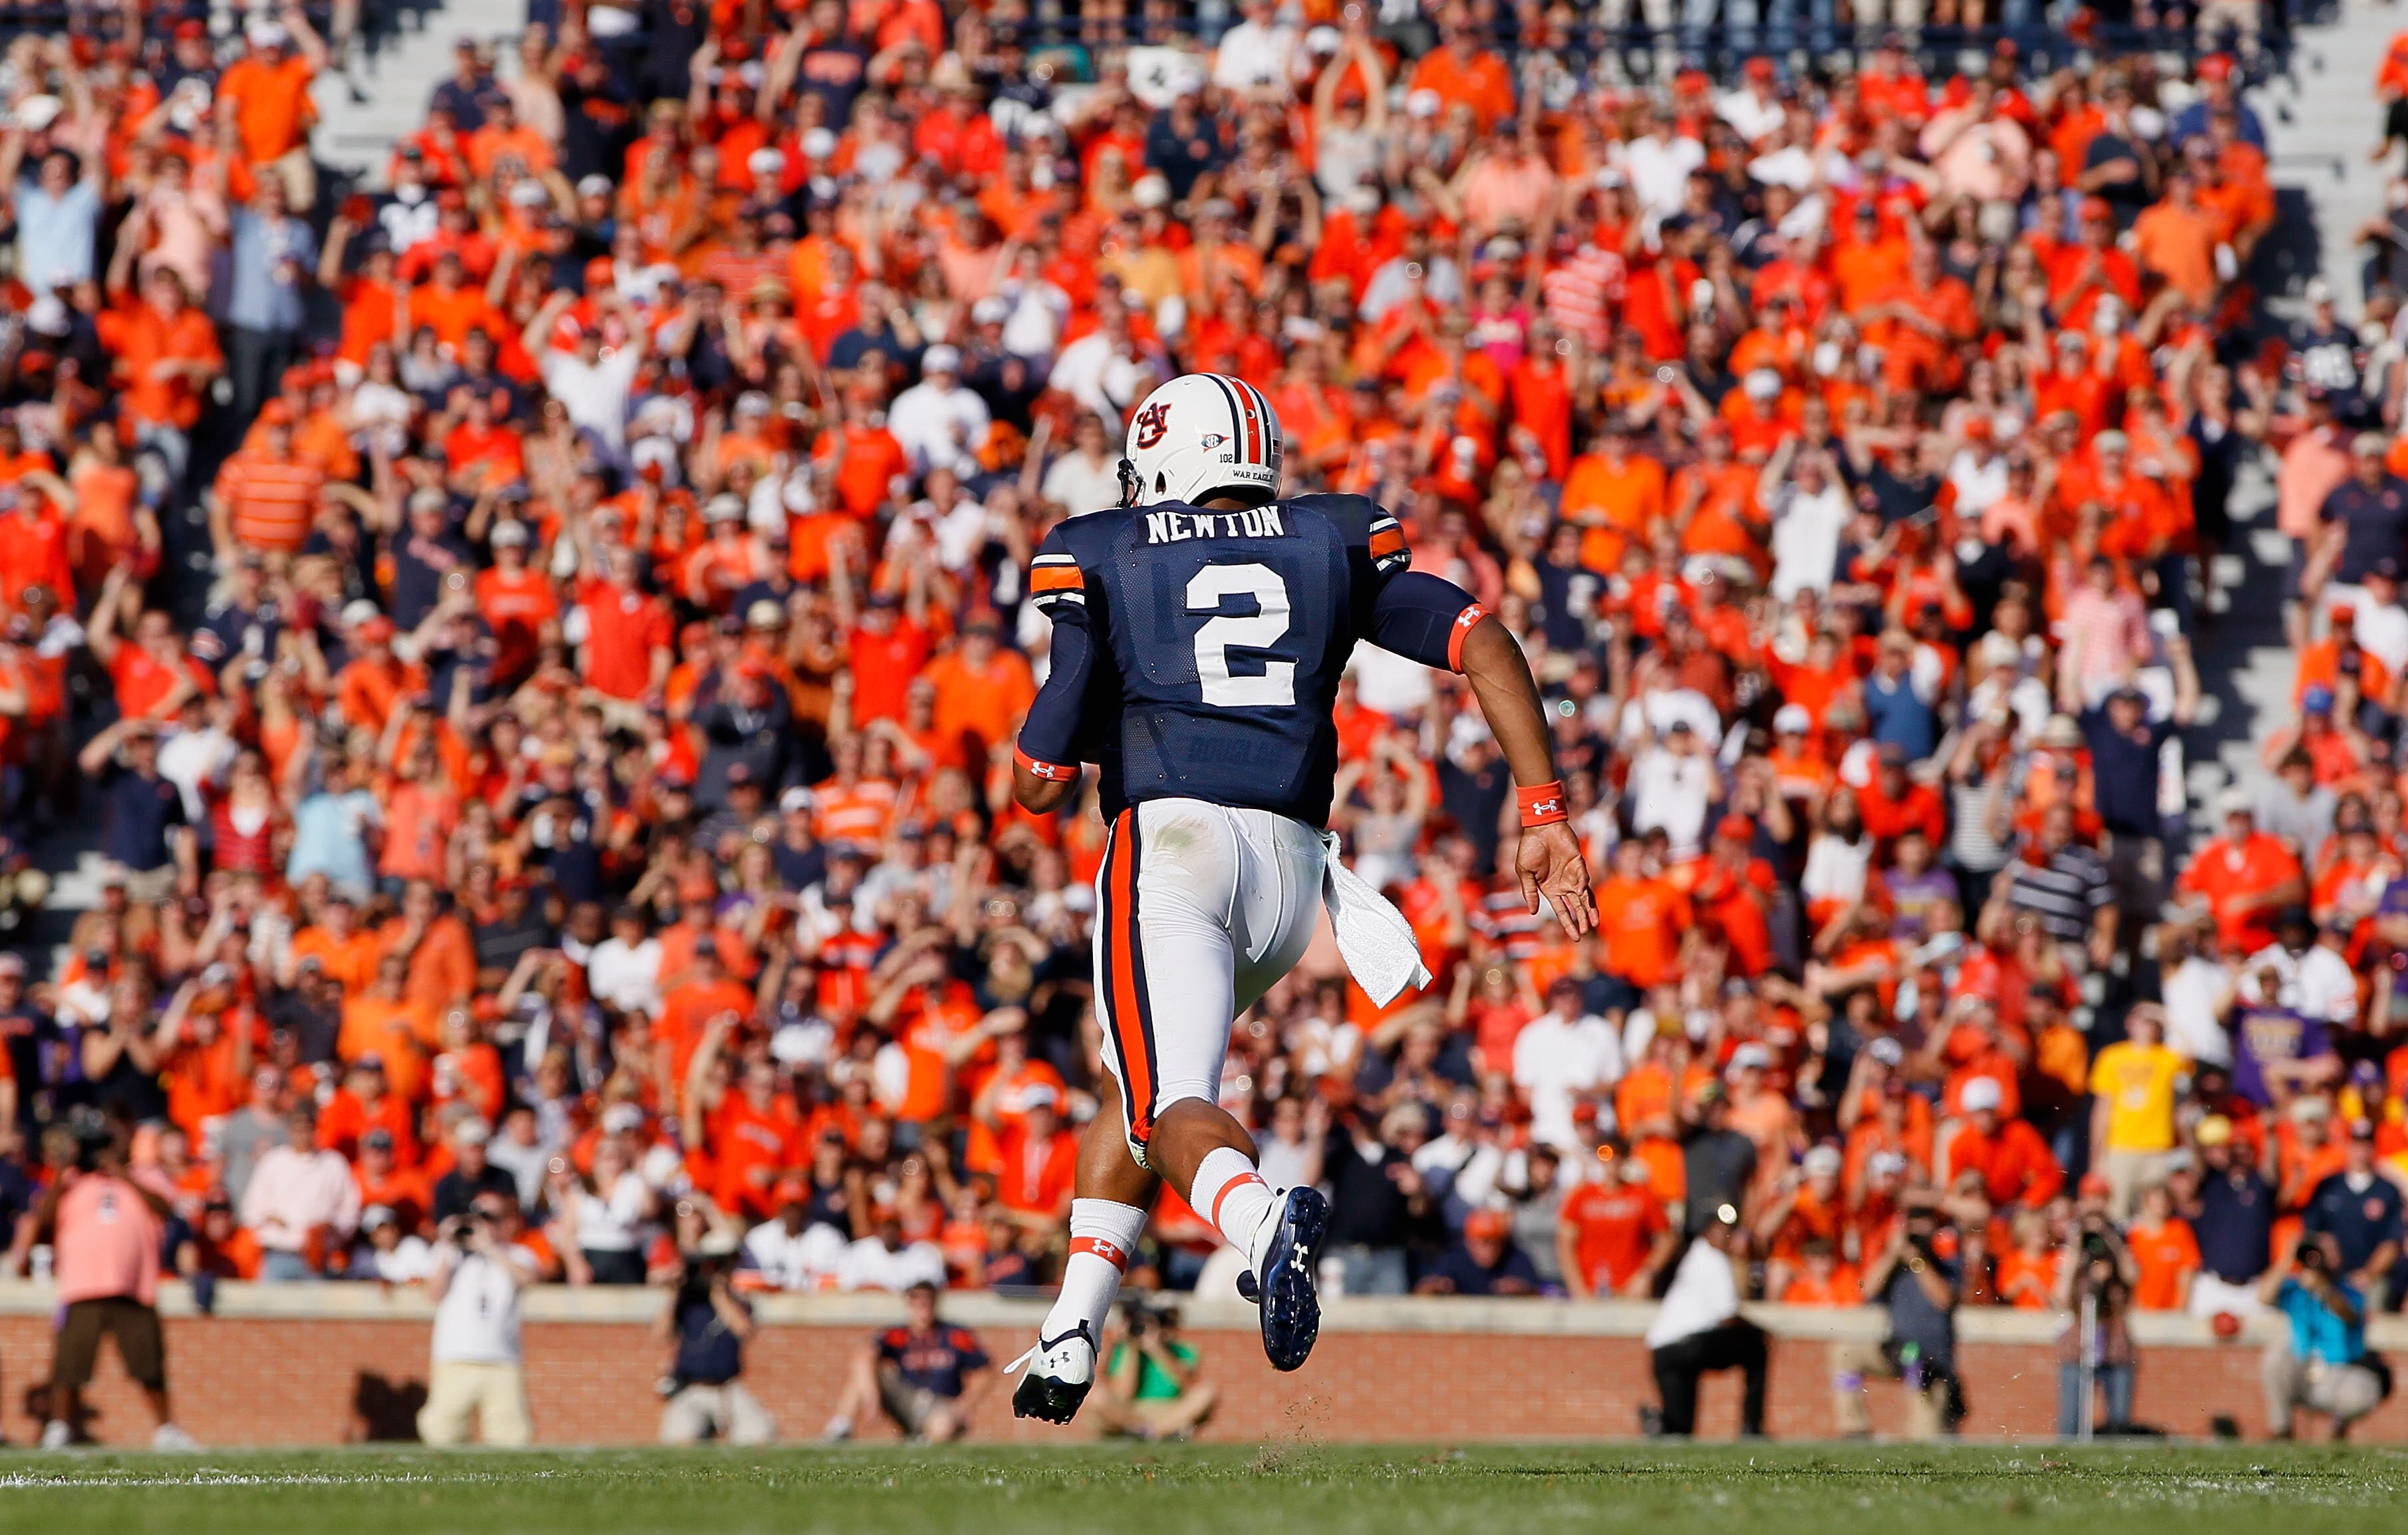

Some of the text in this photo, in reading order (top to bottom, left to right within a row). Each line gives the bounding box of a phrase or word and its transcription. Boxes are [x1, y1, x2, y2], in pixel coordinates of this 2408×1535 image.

[1219, 454, 1233, 463] 102
[1233, 470, 1274, 482] WAR EAGLE
[1145, 506, 1284, 544] NEWTON
[1186, 563, 1296, 707] 2
